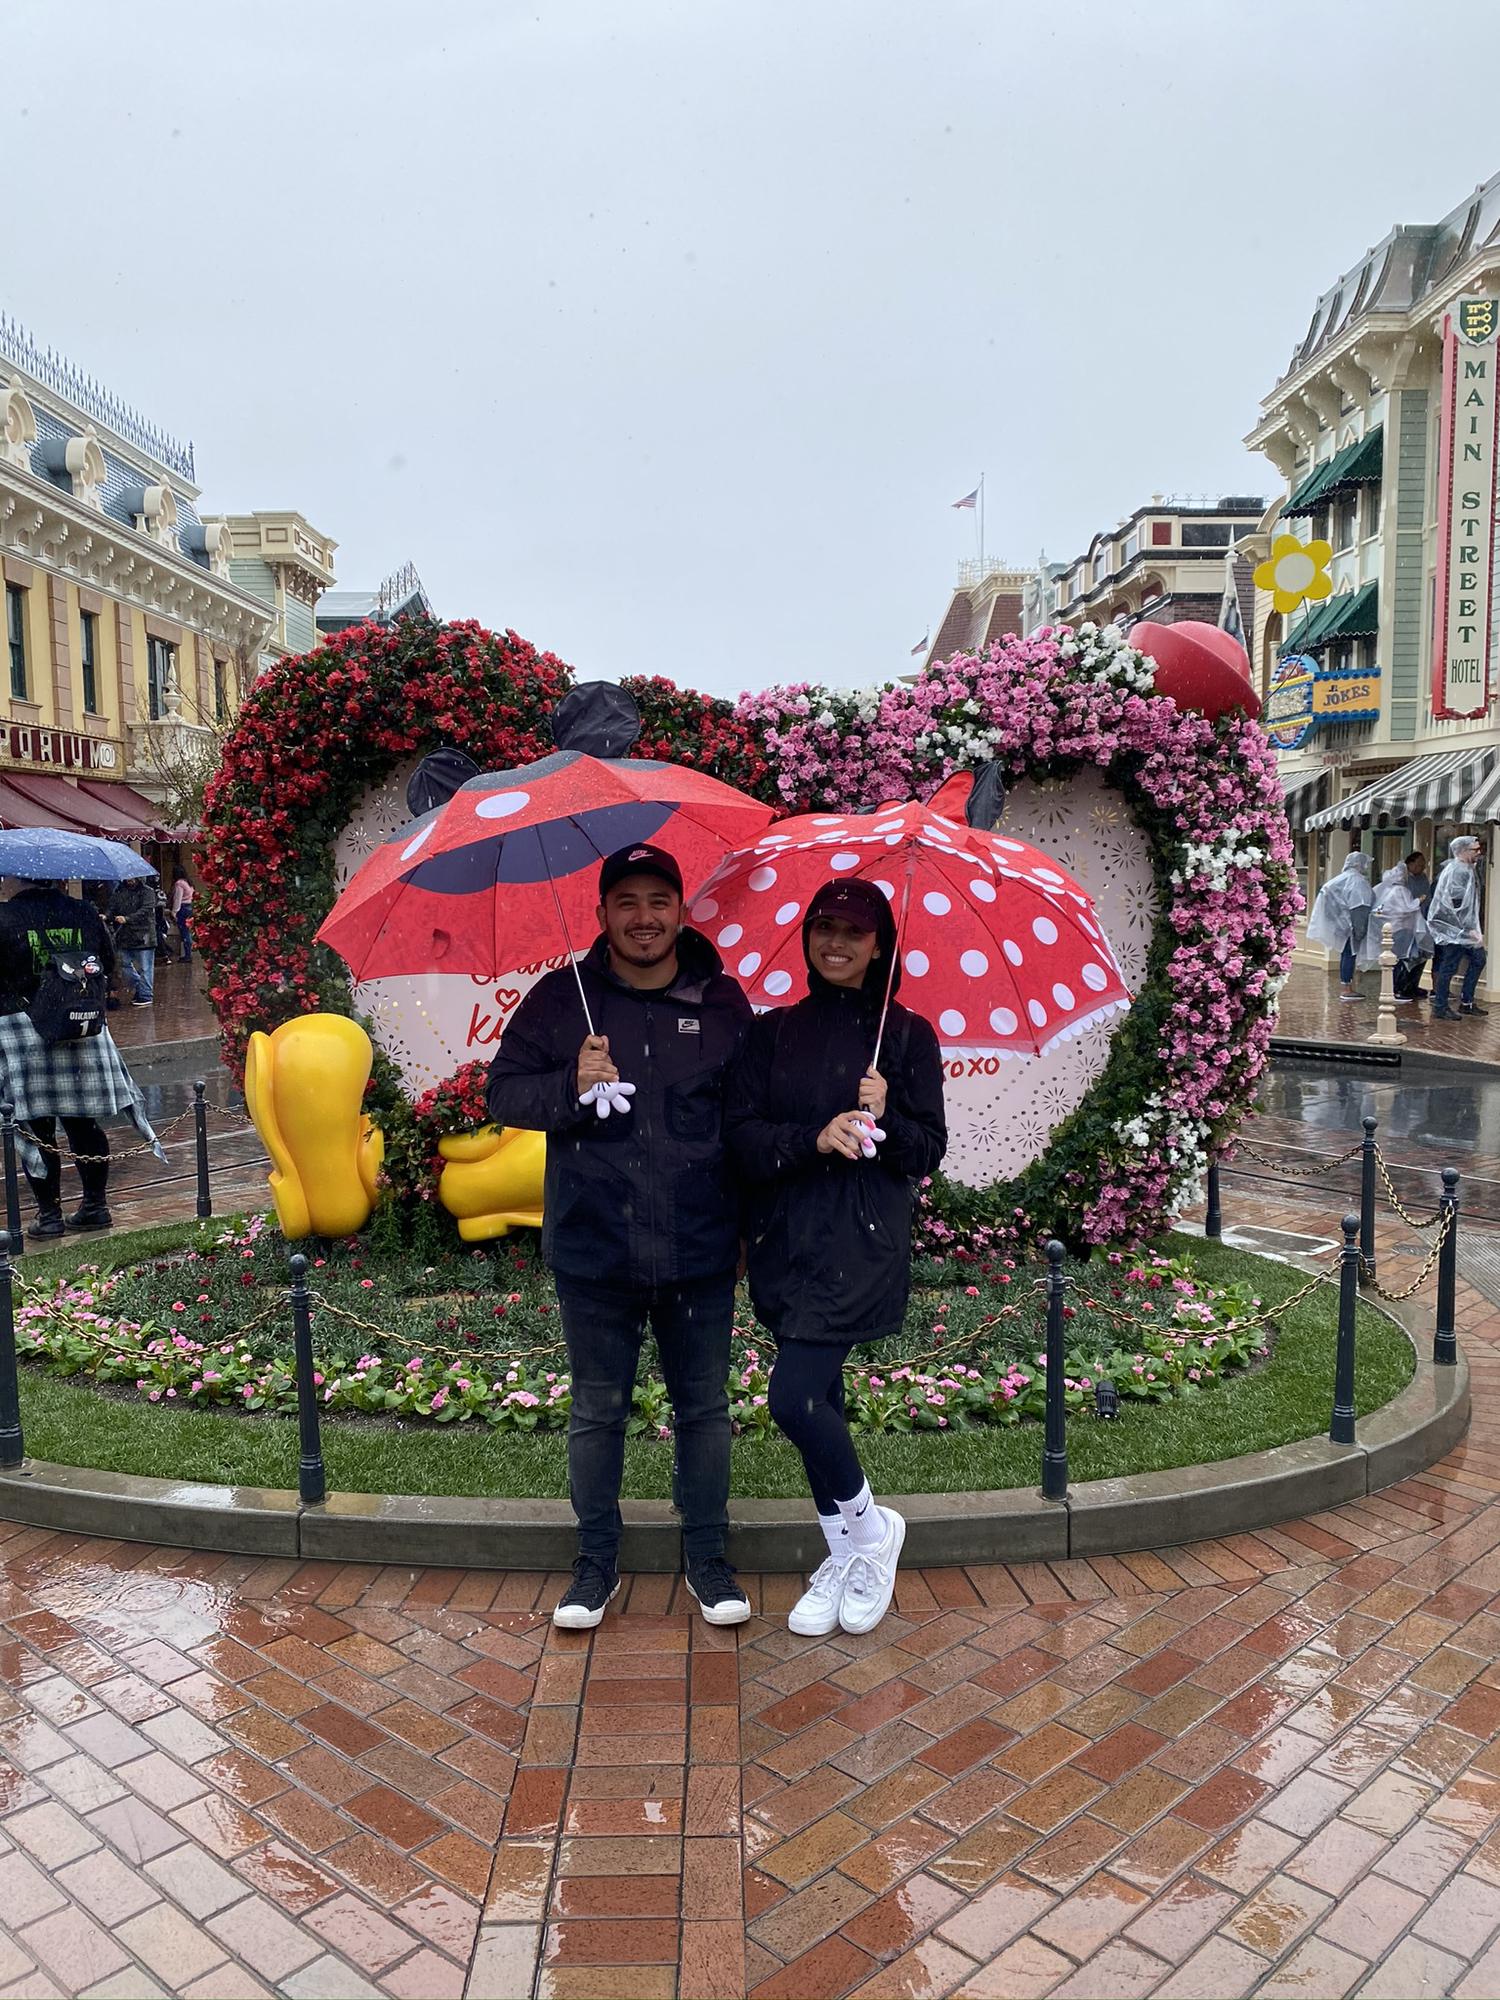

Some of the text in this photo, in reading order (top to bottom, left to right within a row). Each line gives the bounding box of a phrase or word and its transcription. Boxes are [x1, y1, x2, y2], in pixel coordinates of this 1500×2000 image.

[1457, 361, 1486, 644] MAIN STREET
[1451, 659, 1481, 684] HOTEL
[1323, 685, 1370, 706] JOKES
